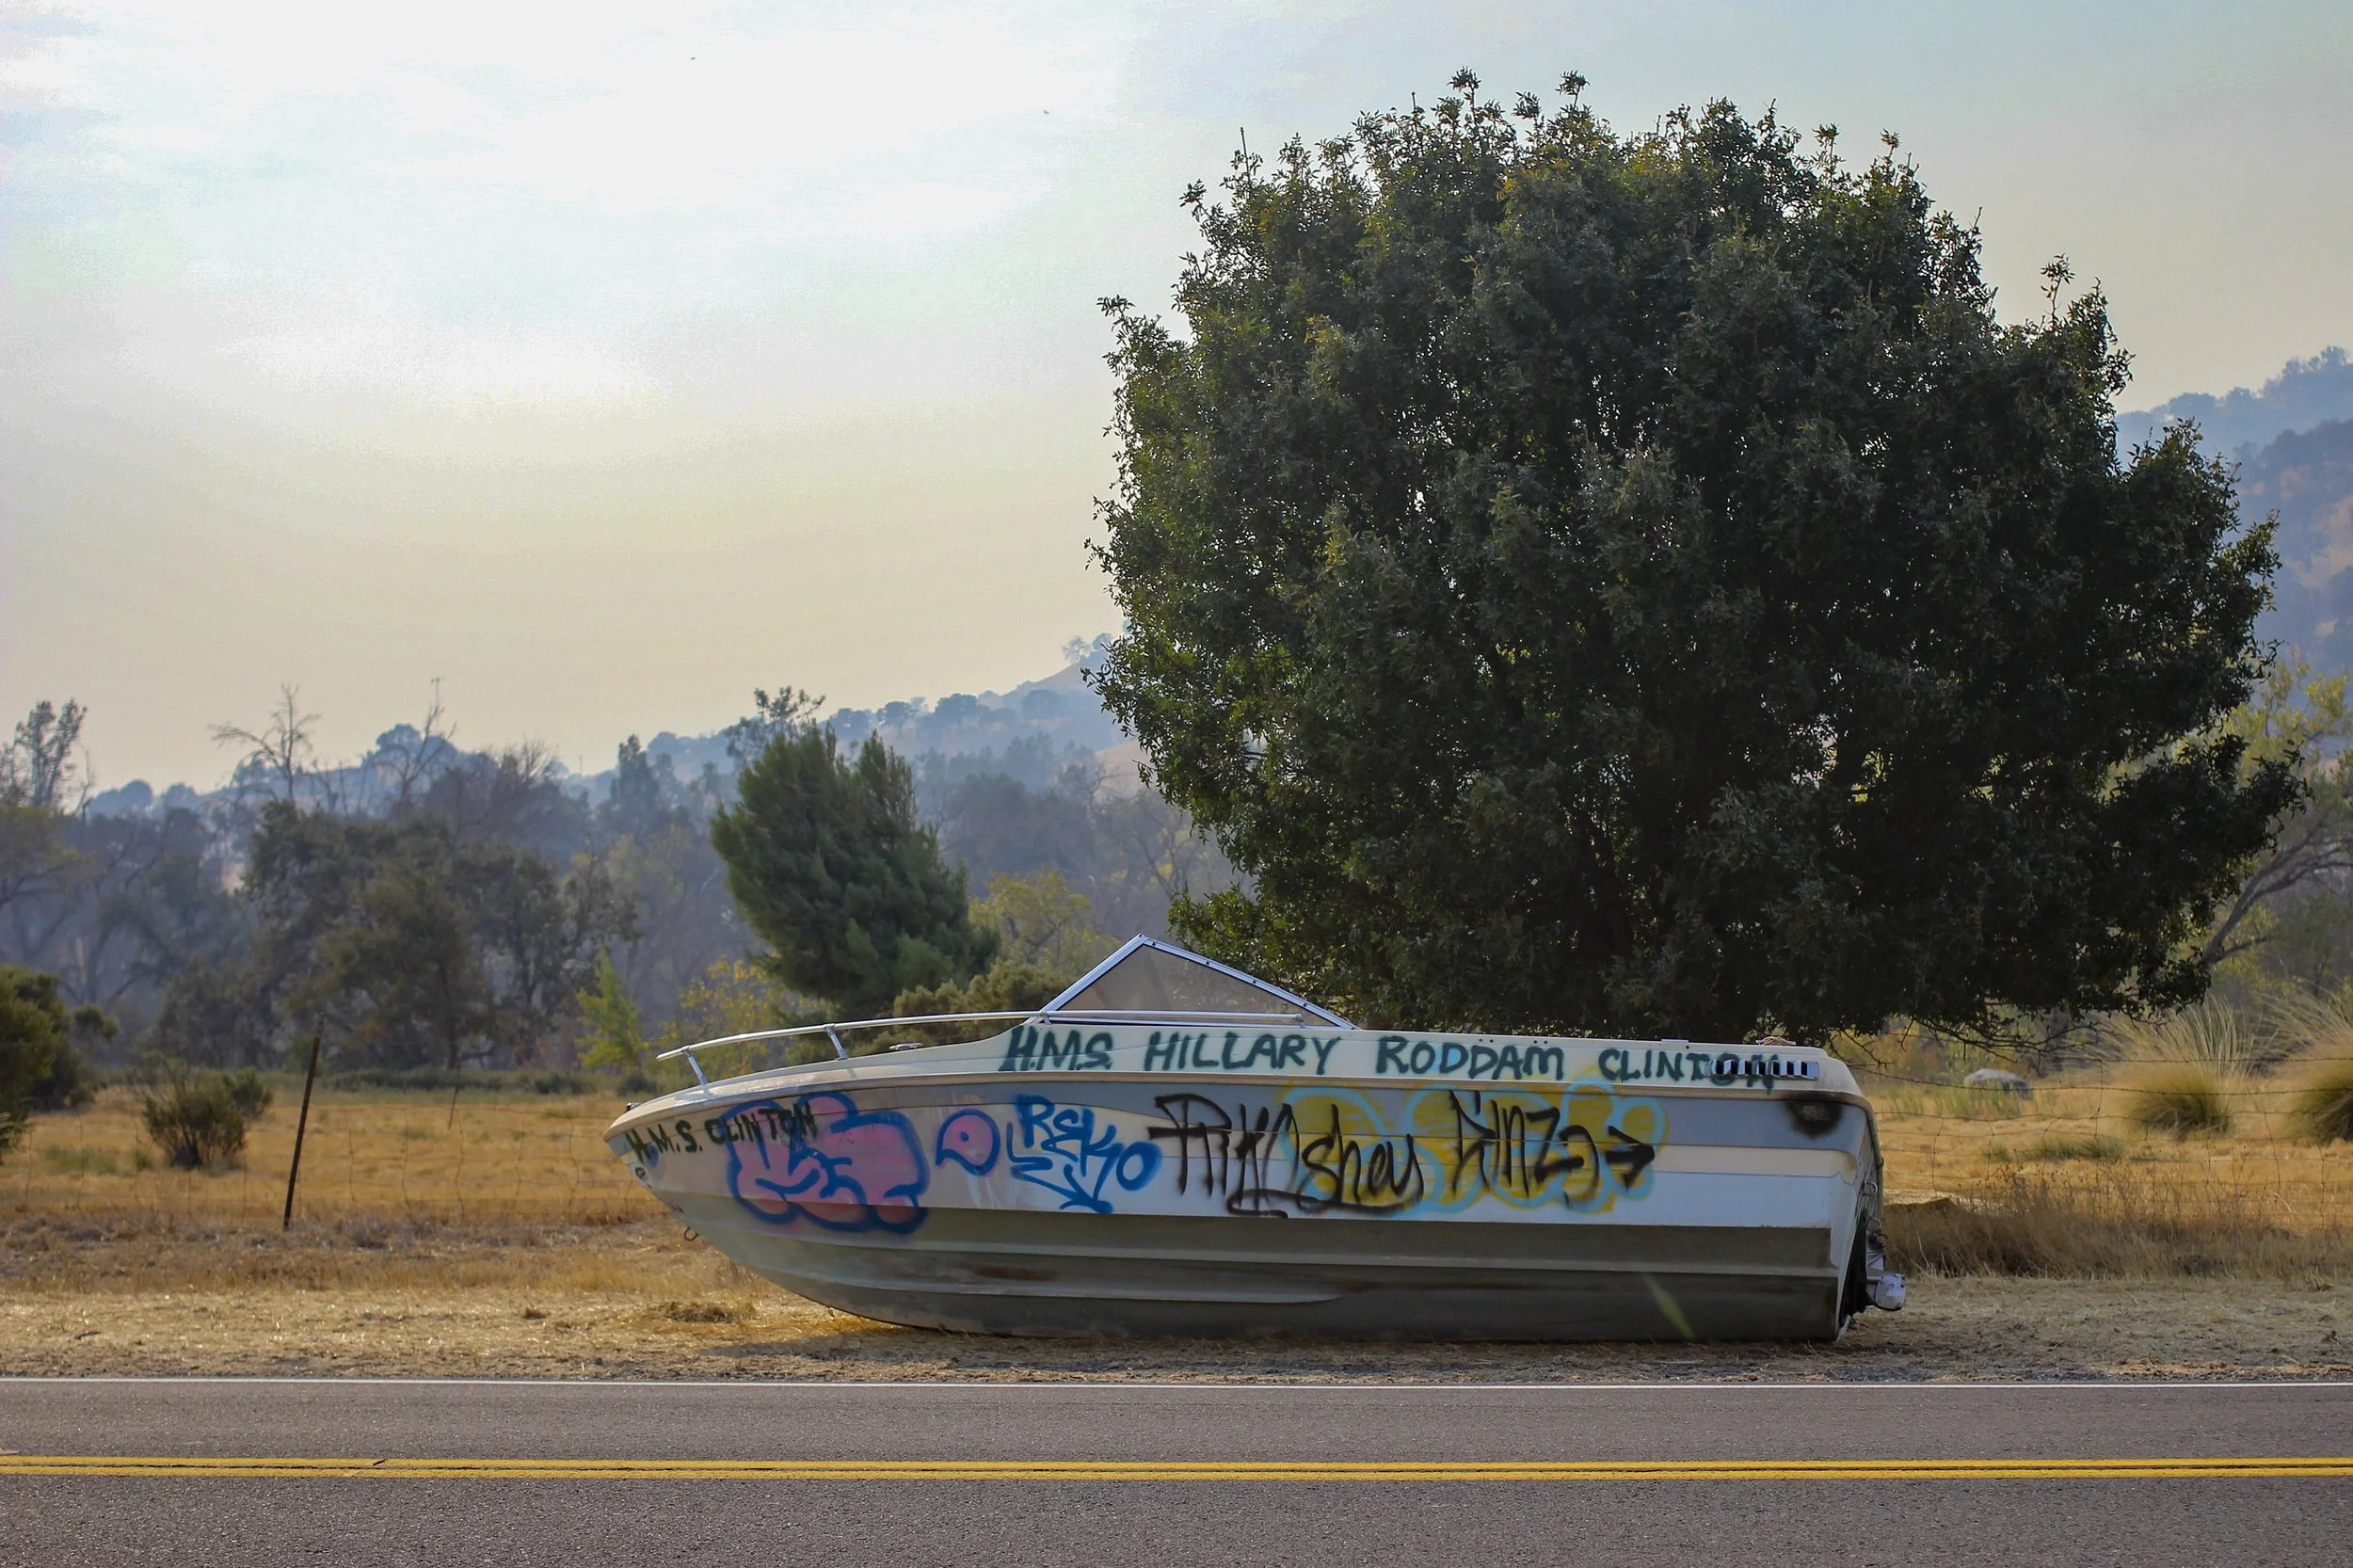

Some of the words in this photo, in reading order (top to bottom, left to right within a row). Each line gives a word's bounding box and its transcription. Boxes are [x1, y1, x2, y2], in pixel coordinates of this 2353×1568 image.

[1144, 1031, 1341, 1075] HILLARY
[1377, 1036, 1564, 1080] RODDAM
[1598, 1048, 1778, 1095] CLINTON
[704, 1099, 818, 1145] CLINTON
